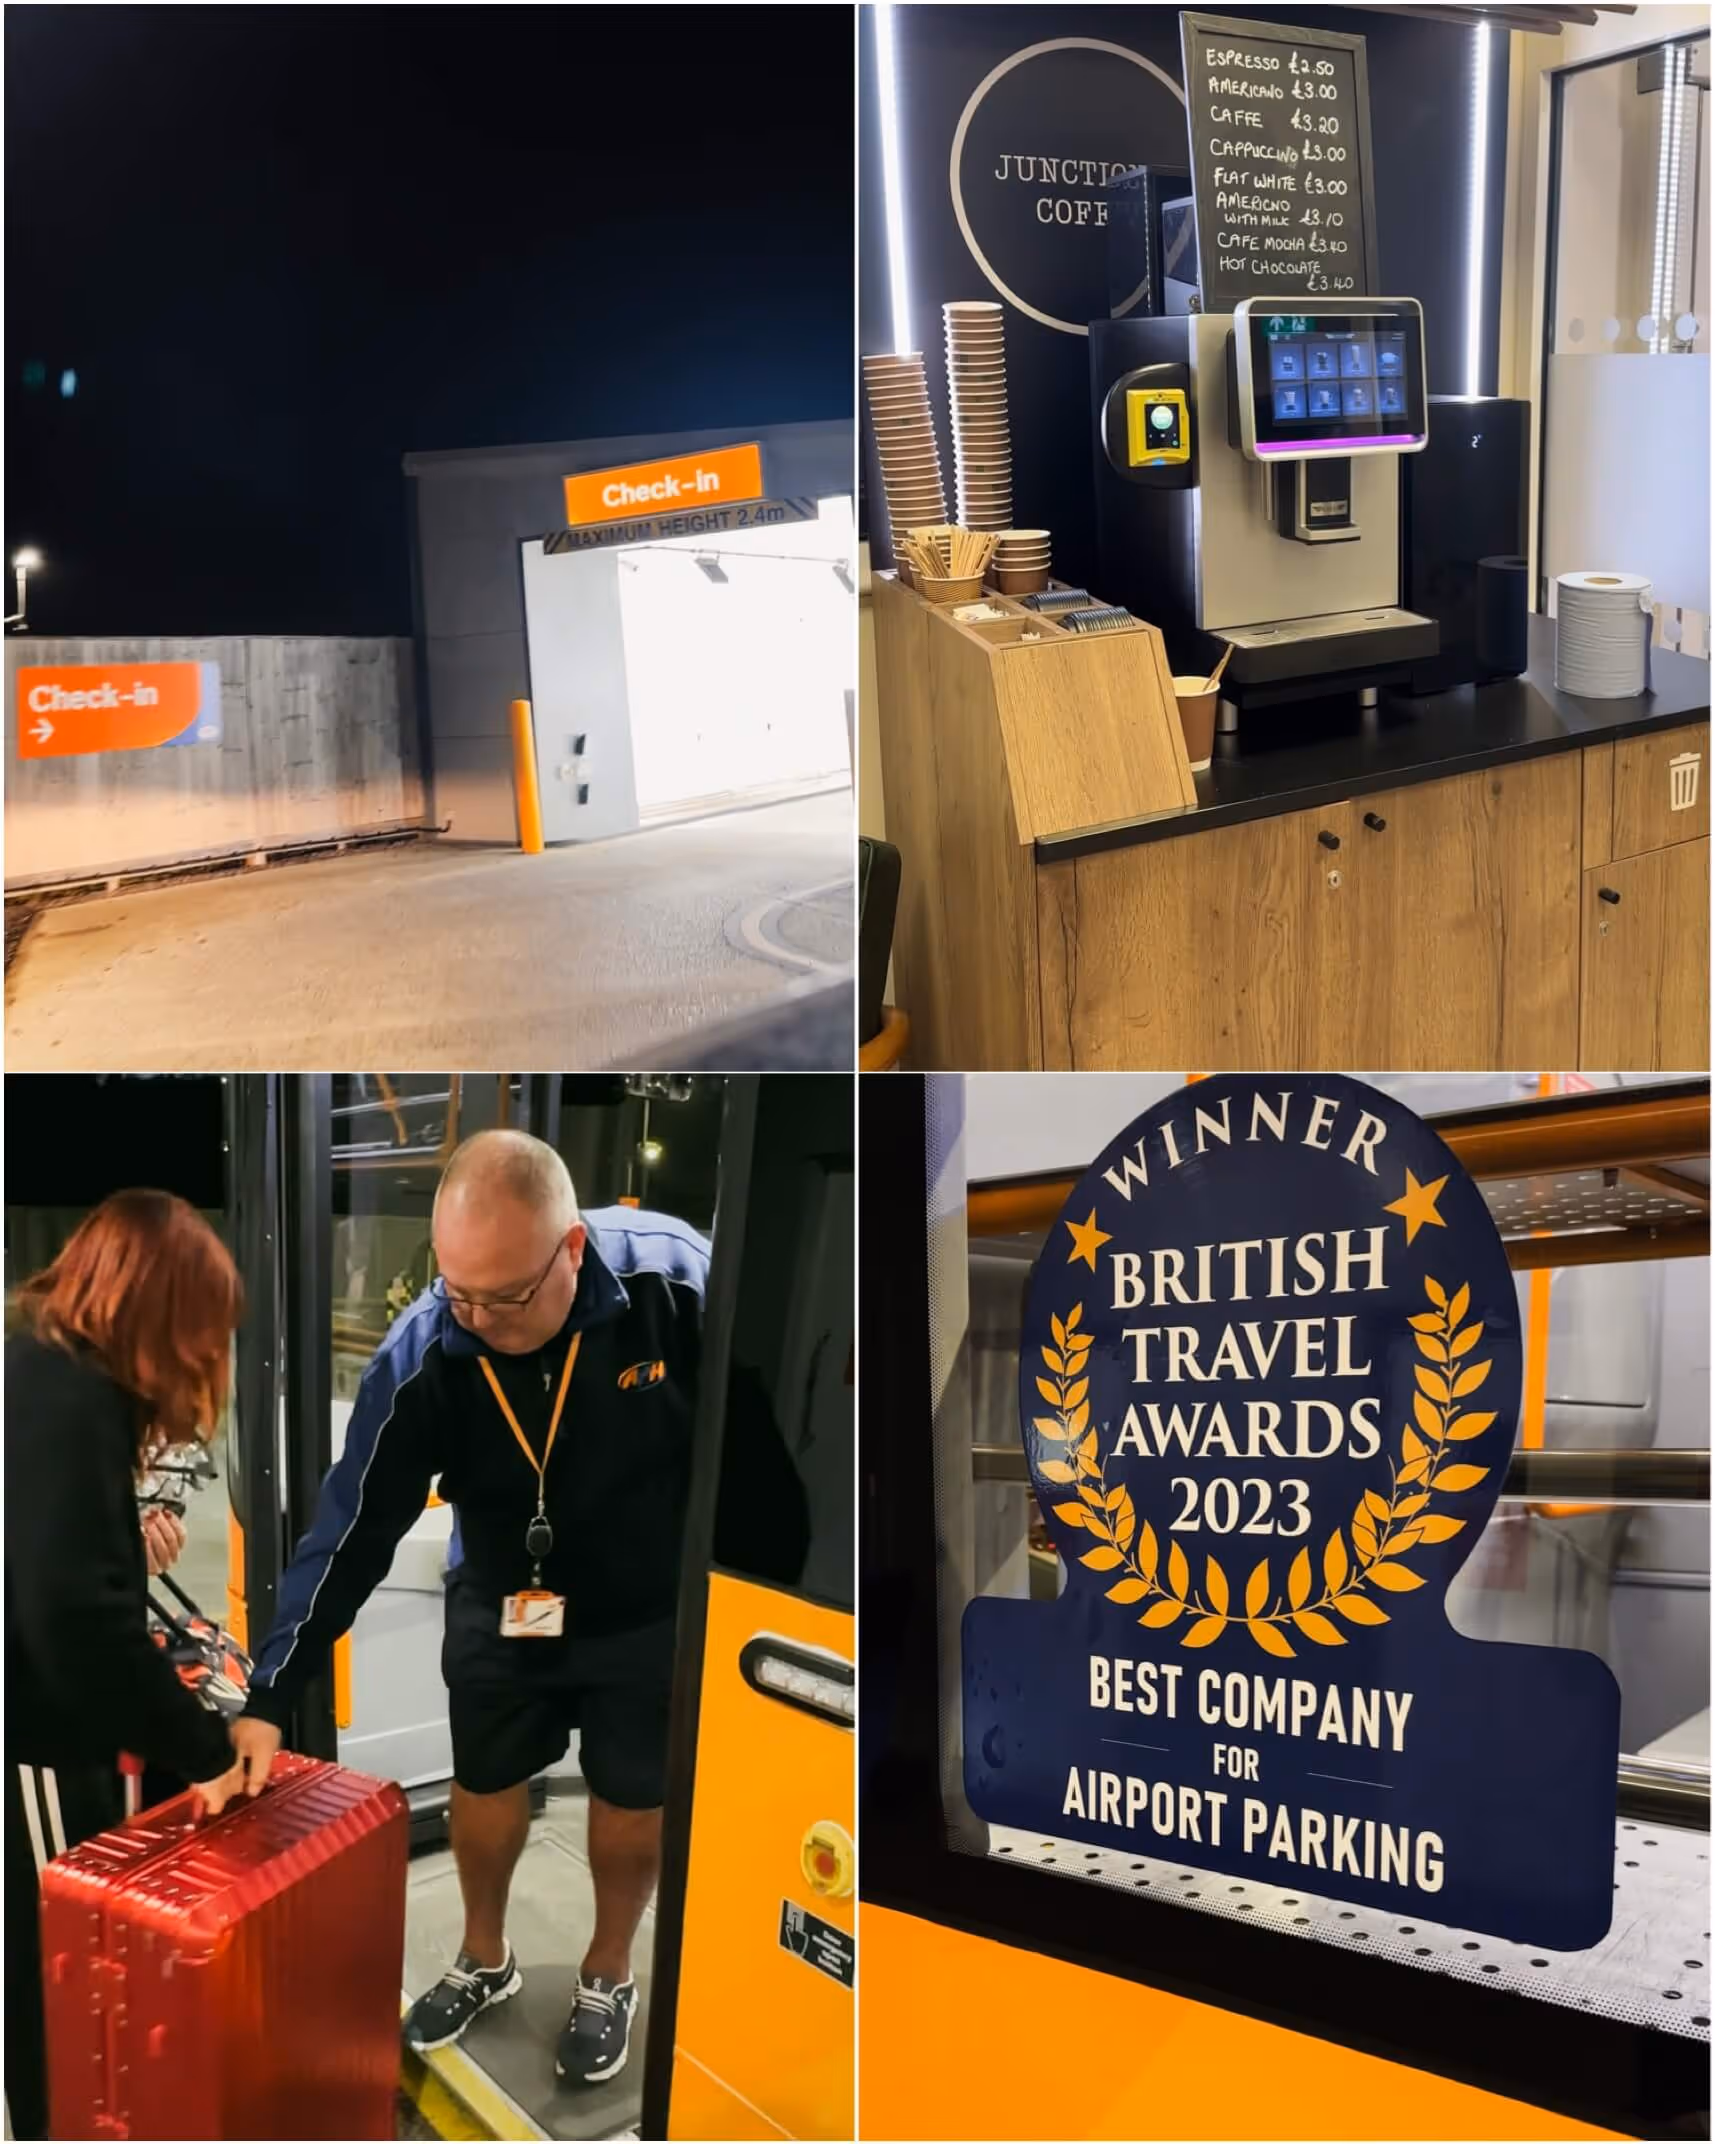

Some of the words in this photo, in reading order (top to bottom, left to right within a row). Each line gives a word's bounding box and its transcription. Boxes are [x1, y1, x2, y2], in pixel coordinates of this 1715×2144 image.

[1206, 48, 1280, 70] ESPRESSO
[1288, 51, 1335, 75] £2.50
[1208, 76, 1283, 99] AMERICANO
[1291, 79, 1337, 100] £3.00
[1210, 105, 1263, 128] CAFFE
[1290, 107, 1339, 134] £3.20
[1210, 138, 1298, 163] CAPPUCCINO
[1302, 139, 1346, 161] £3.00
[995, 154, 1147, 187] JUNCTIO
[1214, 167, 1250, 187] FLAT
[1254, 173, 1297, 191] WHITE
[1304, 171, 1348, 195] £3.00
[1224, 213, 1257, 226] WITH
[1261, 215, 1290, 227] MILK
[1299, 208, 1343, 227] £3.10
[1217, 232, 1260, 250] CAFE
[1264, 237, 1305, 251] MOCHA
[1219, 256, 1247, 272] HOT
[1251, 259, 1321, 275] CHOCOLATE
[1307, 274, 1354, 291] £3.40
[602, 470, 720, 507] Check-in
[658, 510, 731, 536] HEIGHT
[737, 504, 785, 526] 2.4m
[28, 682, 158, 712] Check-in
[1102, 1091, 1388, 1201] WINNER
[1109, 1225, 1390, 1310] BRITISH
[1121, 1315, 1372, 1383] TRAVEL
[1110, 1397, 1382, 1459] AWARDS
[1168, 1476, 1312, 1537] 2023
[1090, 1655, 1183, 1719] BEST
[1198, 1668, 1414, 1752] COMPANY
[1213, 1743, 1260, 1782] FOR
[1062, 1766, 1228, 1847] AIRPORT
[1243, 1797, 1446, 1893] PARKING
